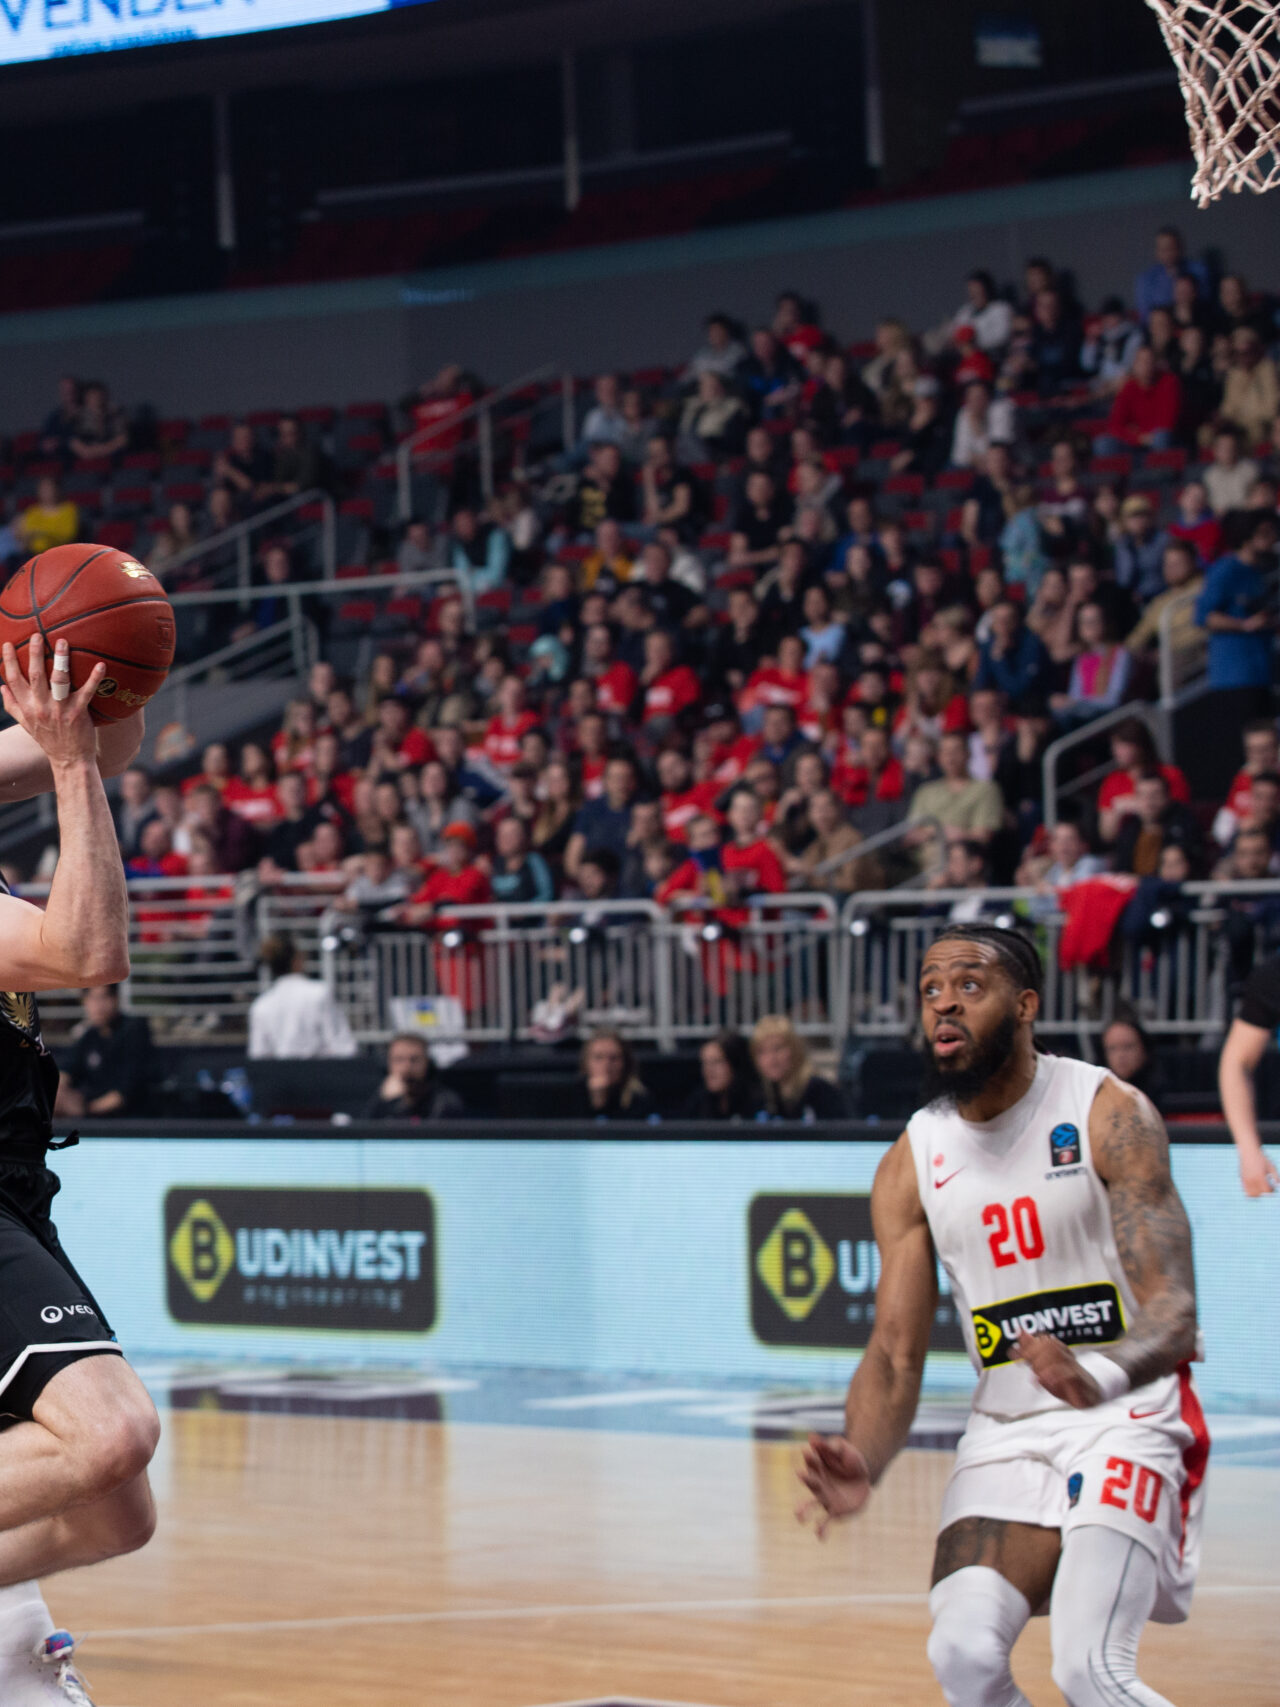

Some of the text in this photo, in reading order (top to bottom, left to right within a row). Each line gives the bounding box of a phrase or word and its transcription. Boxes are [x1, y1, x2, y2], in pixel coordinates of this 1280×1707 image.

[191, 1221, 425, 1281] BUDINVEST
[981, 1195, 1046, 1268] 20
[976, 1299, 1114, 1345] BUDNVEST
[1099, 1456, 1163, 1524] 20
